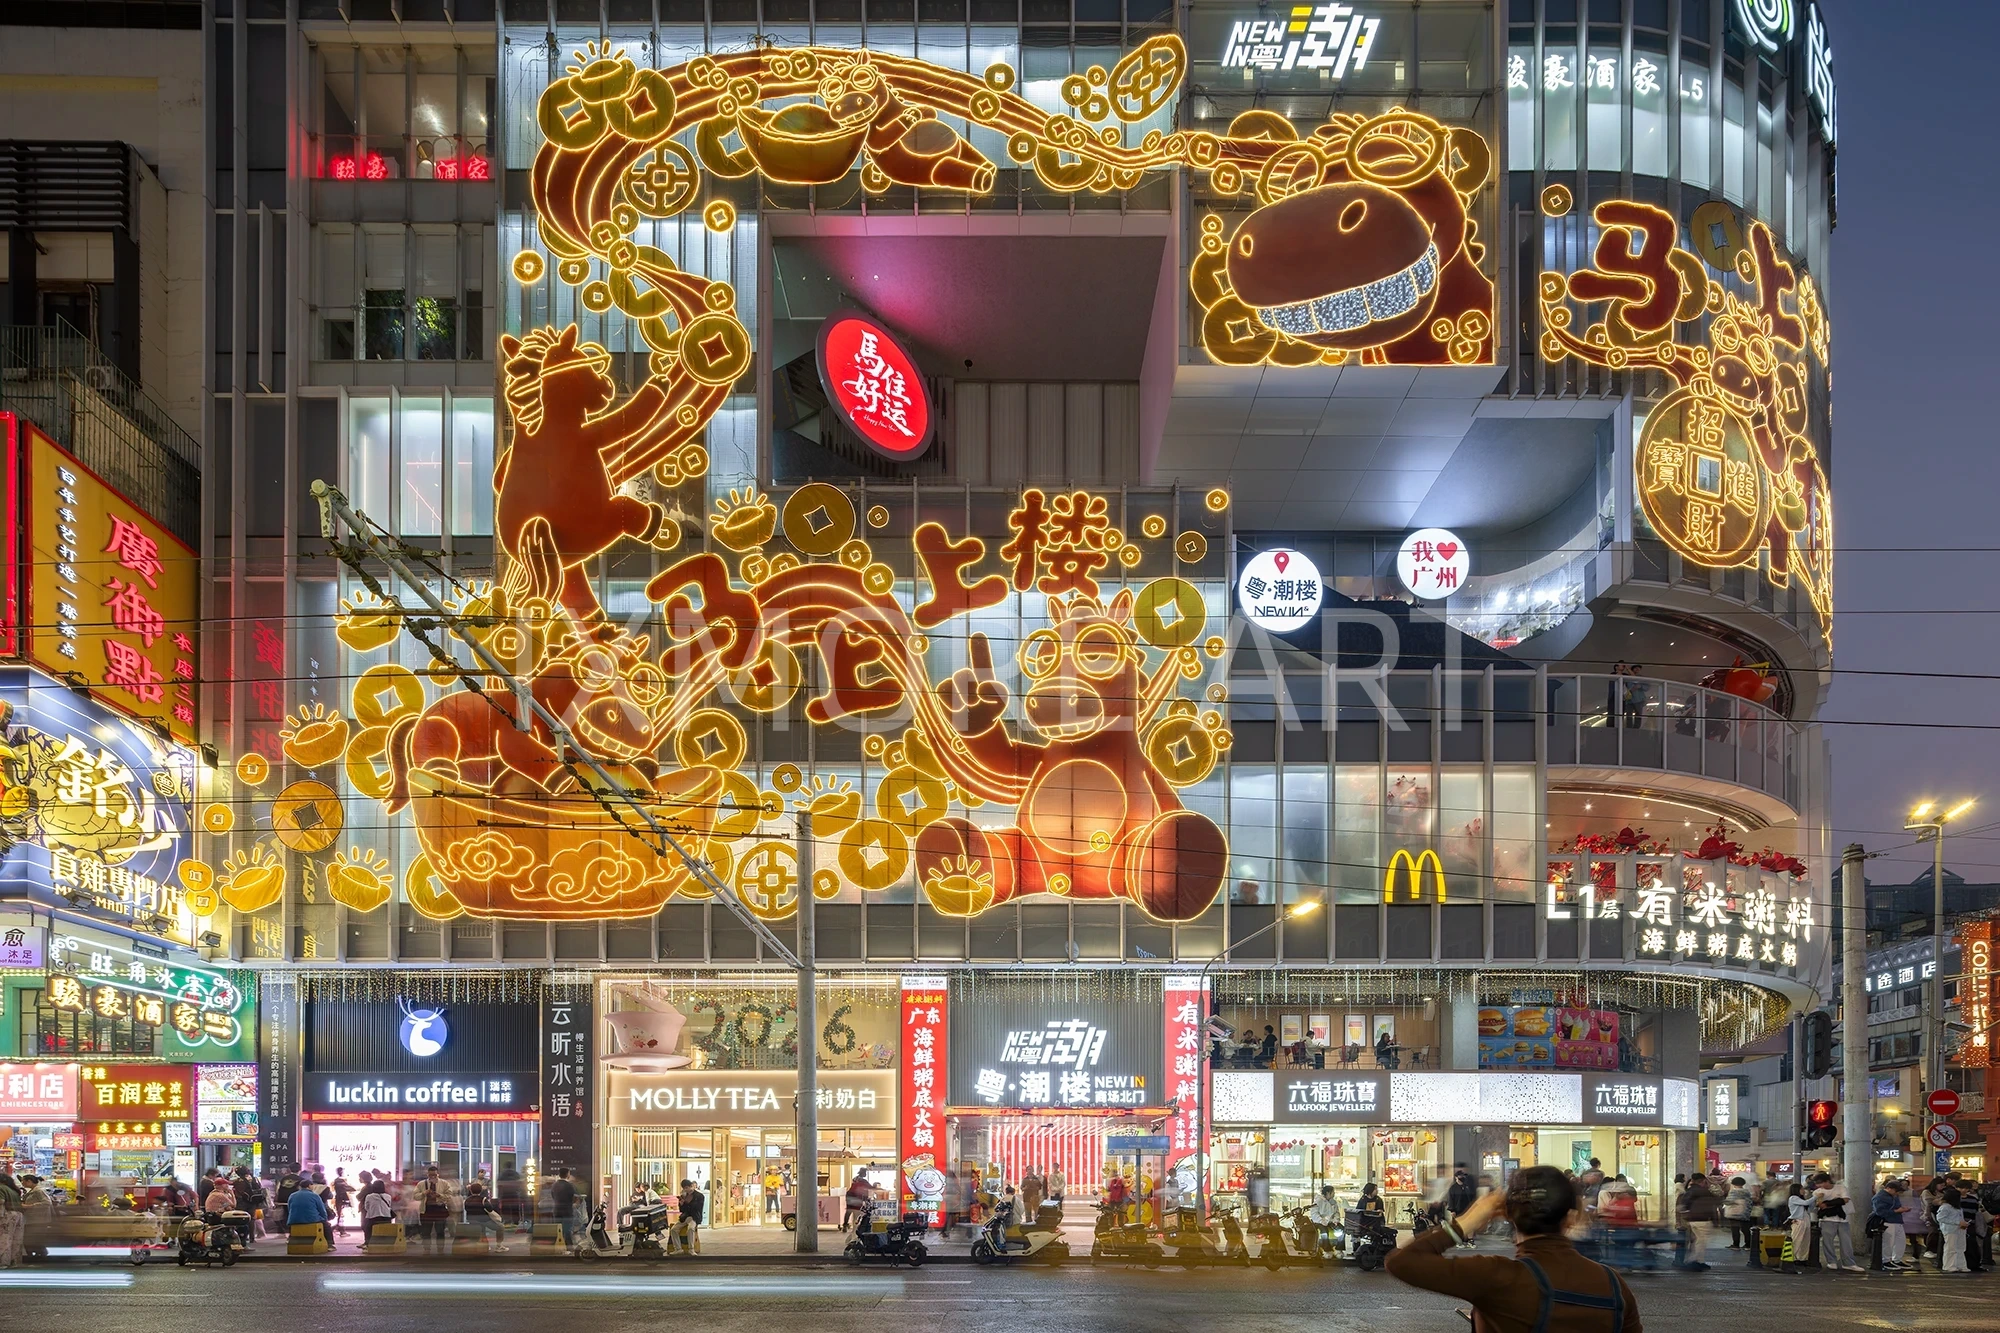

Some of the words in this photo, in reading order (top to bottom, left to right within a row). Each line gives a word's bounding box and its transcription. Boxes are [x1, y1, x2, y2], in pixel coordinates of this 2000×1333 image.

[1412, 541, 1434, 563] 我
[1412, 567, 1458, 589] 广州
[1629, 877, 1815, 942] 有米粥料
[8, 949, 32, 959] 沐足
[1642, 928, 1798, 967] 海鲜粥底火锅
[91, 952, 206, 996] 旺角冰室
[49, 976, 199, 1031] 駿豪酒家
[908, 1007, 941, 1024] 广东
[329, 1081, 398, 1103] luckin
[405, 1081, 478, 1103] coffee
[489, 1081, 512, 1092] 瑞幸
[912, 1027, 936, 1149] 海鲜粥底火锅
[1095, 1075, 1127, 1087] NEW
[1130, 1076, 1146, 1087] IN
[1288, 1081, 1377, 1103] 六福珠寶
[95, 1082, 166, 1105] 百润堂
[169, 1082, 182, 1108] 凉茶
[489, 1092, 512, 1103] 咖啡
[630, 1088, 721, 1110] MOLLY
[725, 1088, 780, 1110] TEA
[795, 1089, 876, 1110] 莉奶白
[1094, 1090, 1145, 1103] 商场北门
[1595, 1083, 1658, 1107] 六福珠寶
[1714, 1083, 1730, 1126] 六福珠寶
[1289, 1103, 1328, 1112] LUKFOOK
[1329, 1103, 1376, 1112] JEWELLERY
[1596, 1105, 1627, 1113] LUKFOOK
[1627, 1106, 1657, 1115] JEWELLERY
